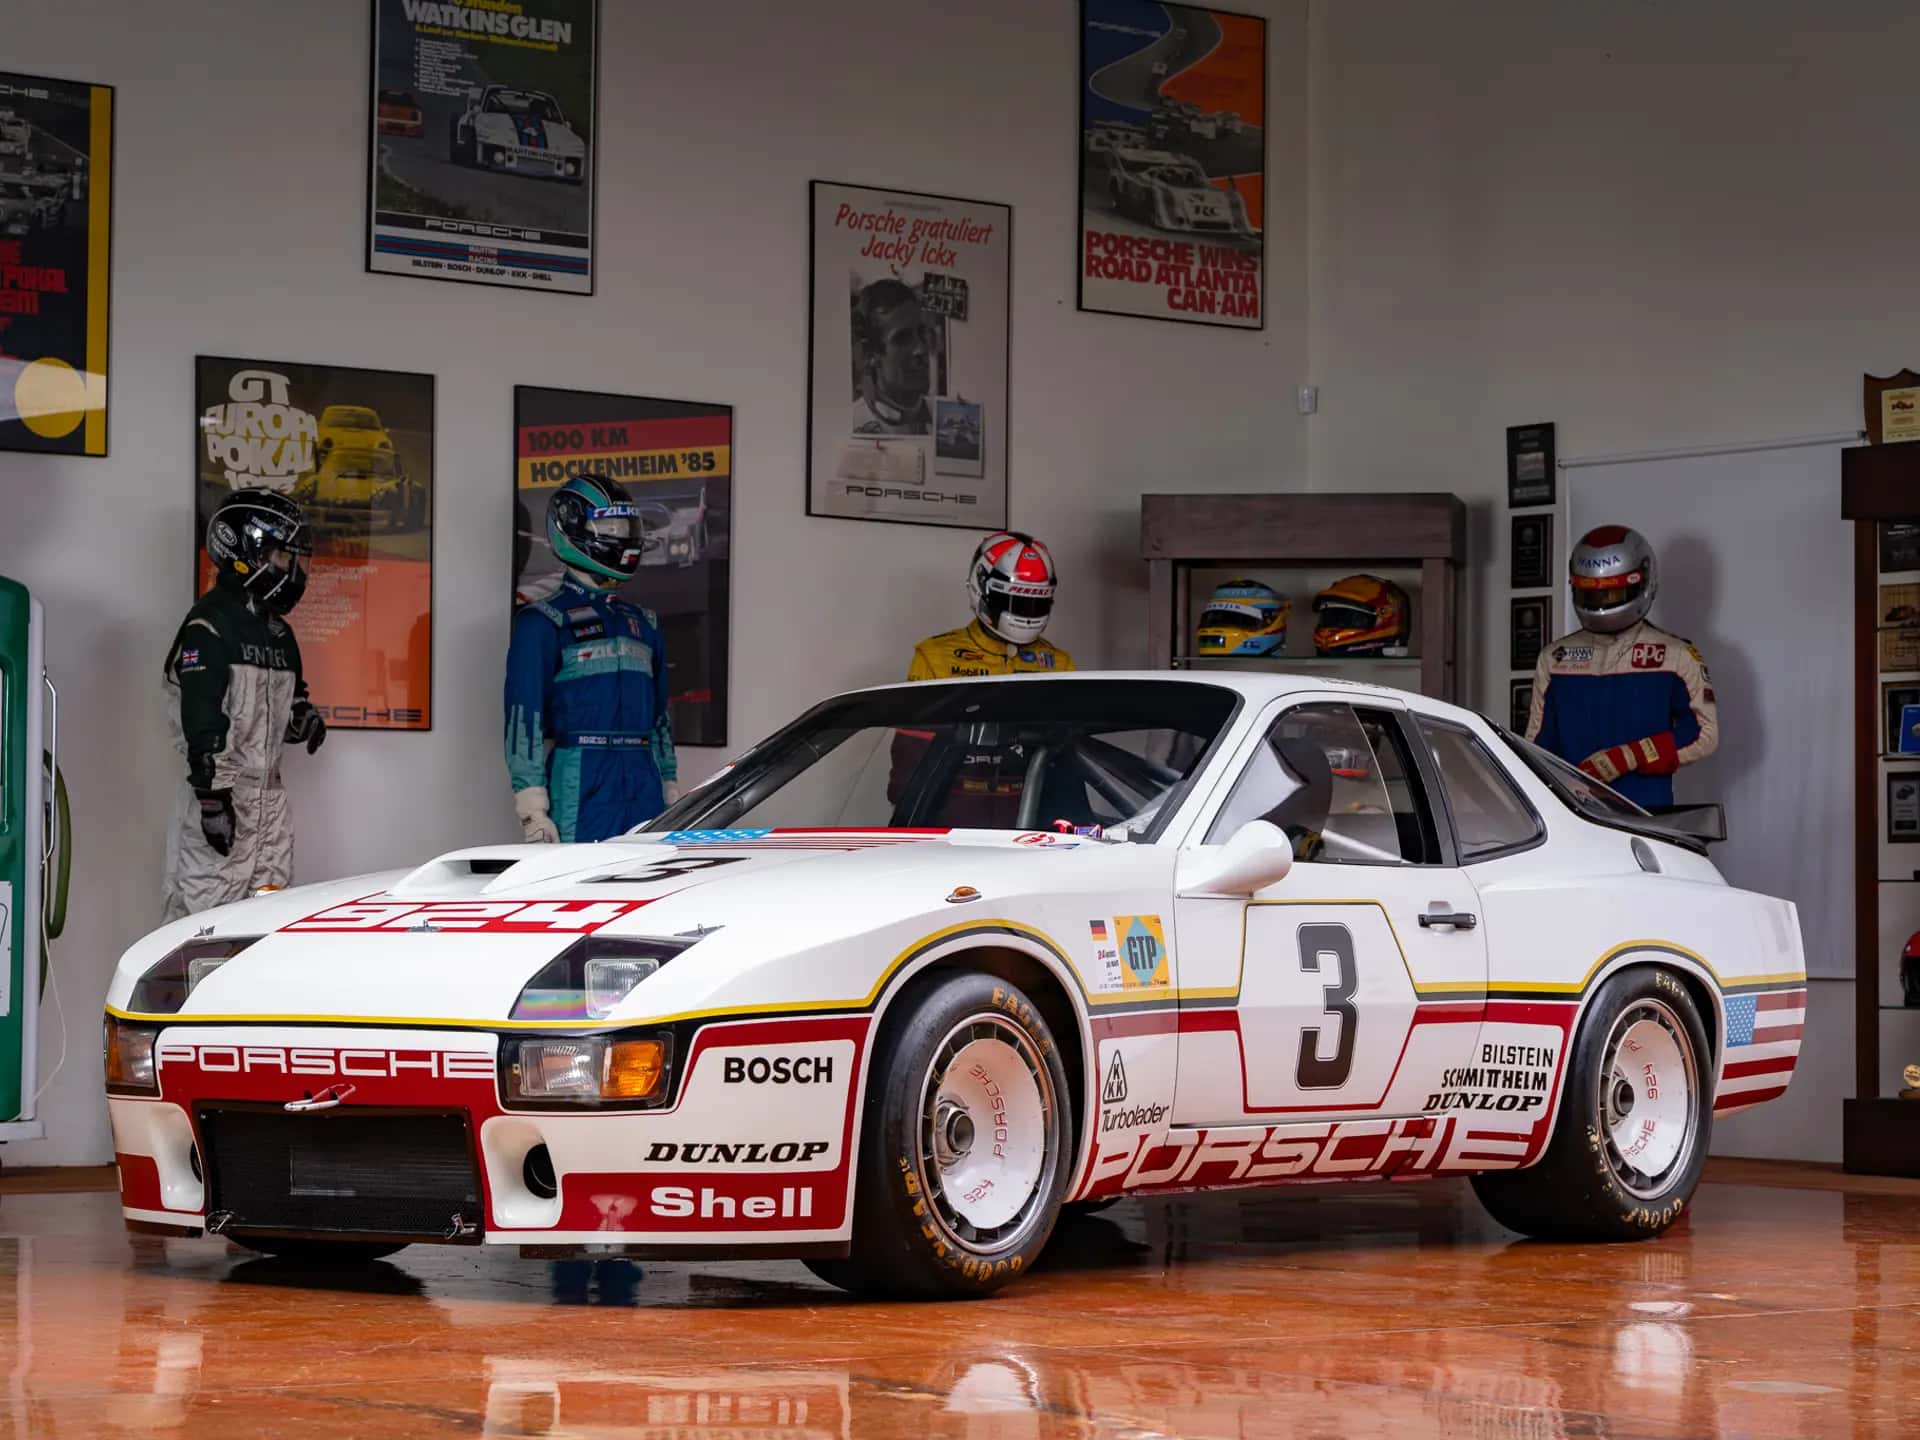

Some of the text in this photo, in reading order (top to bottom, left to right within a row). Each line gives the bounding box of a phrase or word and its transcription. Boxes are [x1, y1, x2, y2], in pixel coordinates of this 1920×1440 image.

[403, 0, 508, 35] WATKINS
[510, 17, 572, 43] GLEN
[425, 219, 541, 241] PORSCHE
[835, 204, 906, 235] Porsche
[909, 218, 993, 245] gratuliert
[861, 234, 958, 268] Jacky Ickx
[1086, 231, 1258, 271] PORSCHE WINS
[412, 259, 443, 270] BILSTEIN
[447, 263, 473, 273] BOSCH
[476, 267, 506, 276] DUNLOP
[532, 273, 552, 281] SHELL
[1086, 255, 1258, 295] ROAD ATLANTA
[229, 369, 291, 405] GT
[203, 402, 319, 442] EUROPA
[207, 432, 314, 476] POKAL
[528, 427, 630, 452] 1000 KM
[531, 454, 679, 482] HOCKENHEIM
[846, 485, 977, 505] PORSCHE
[1633, 645, 1665, 666] PPG
[278, 899, 655, 932] 924
[1126, 936, 1157, 970] GTP
[1296, 922, 1359, 1090] 3
[159, 1045, 495, 1079] PORSCHE
[724, 1057, 833, 1084] BOSCH
[1482, 1044, 1553, 1068] BILSTEIN
[1643, 1064, 1658, 1101] 924
[969, 1064, 1008, 1159] PORSCHE
[1102, 1102, 1169, 1132] Turbolader
[1423, 1093, 1543, 1112] DUNLOP
[644, 1142, 829, 1163] DUNLOP
[1085, 1118, 1529, 1200] PORSCHE
[651, 1186, 813, 1218] Shell
[963, 1178, 995, 1204] 924
